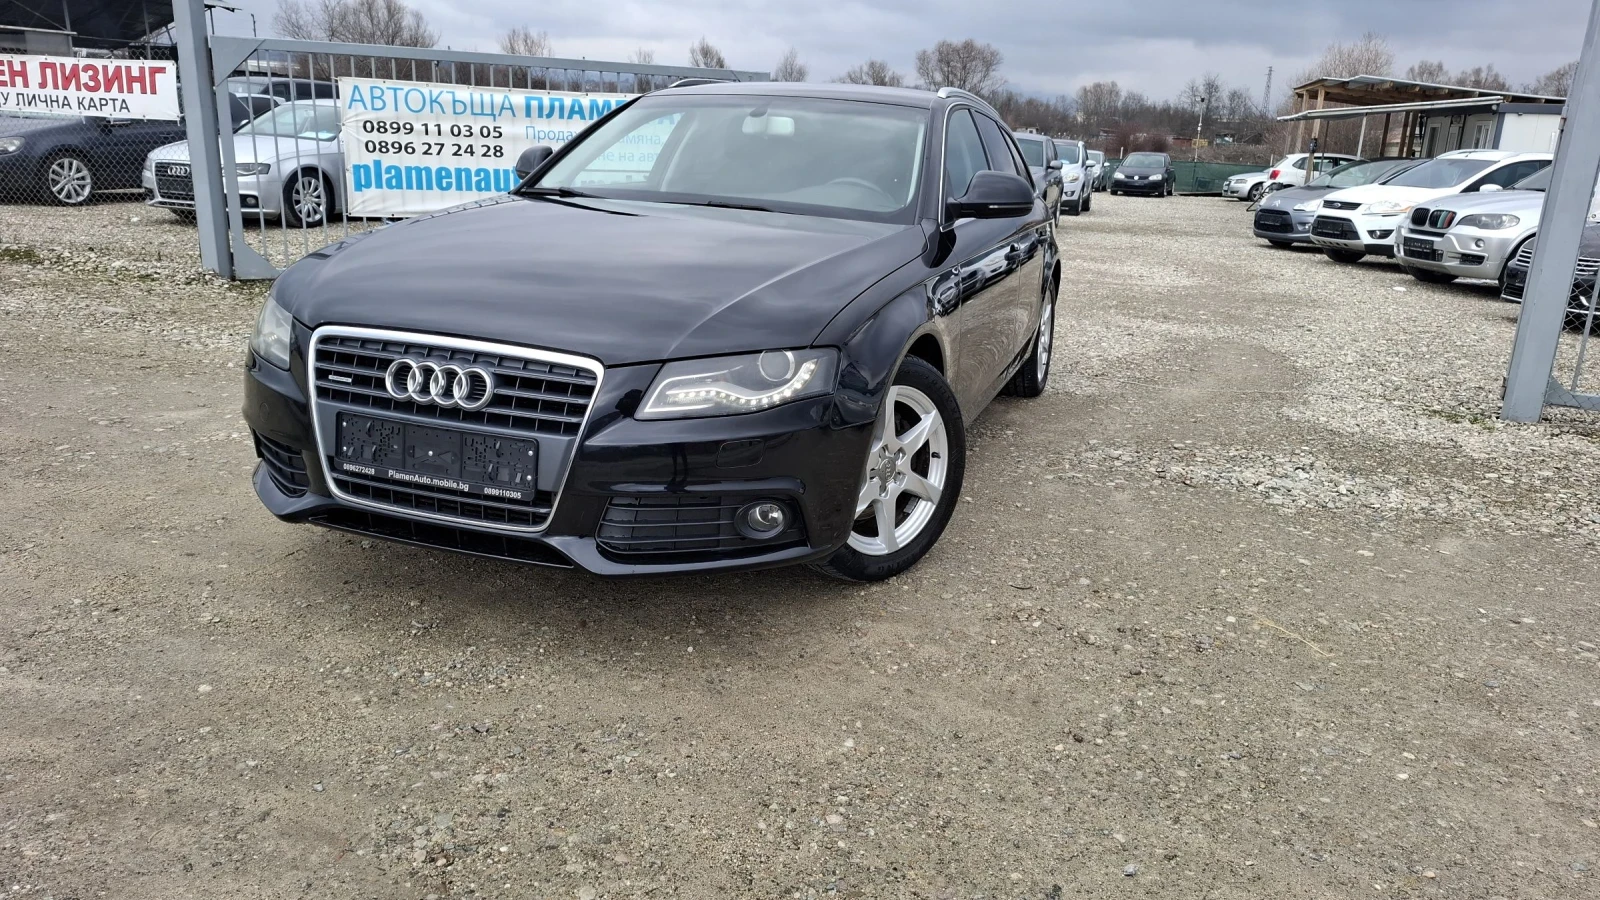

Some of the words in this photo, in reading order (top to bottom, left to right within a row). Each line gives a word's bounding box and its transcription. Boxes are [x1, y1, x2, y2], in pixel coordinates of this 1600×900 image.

[38, 62, 166, 95] ЛИЗИНГ
[0, 91, 10, 105] У
[16, 92, 73, 110] ЛИЧНА
[77, 96, 131, 113] КАРТА
[347, 84, 516, 122] АВТОКЪЩА
[524, 96, 631, 121] ПЛАМ
[362, 120, 415, 136] 0899
[421, 123, 442, 137] 11
[450, 124, 474, 138] 03
[479, 125, 503, 139] 05
[525, 125, 578, 143] Прода
[364, 140, 416, 156] 0896
[421, 142, 445, 157] 27
[451, 143, 475, 158] 24
[480, 144, 504, 159] 28
[388, 469, 470, 492] PlamenAuto.mobile.bg
